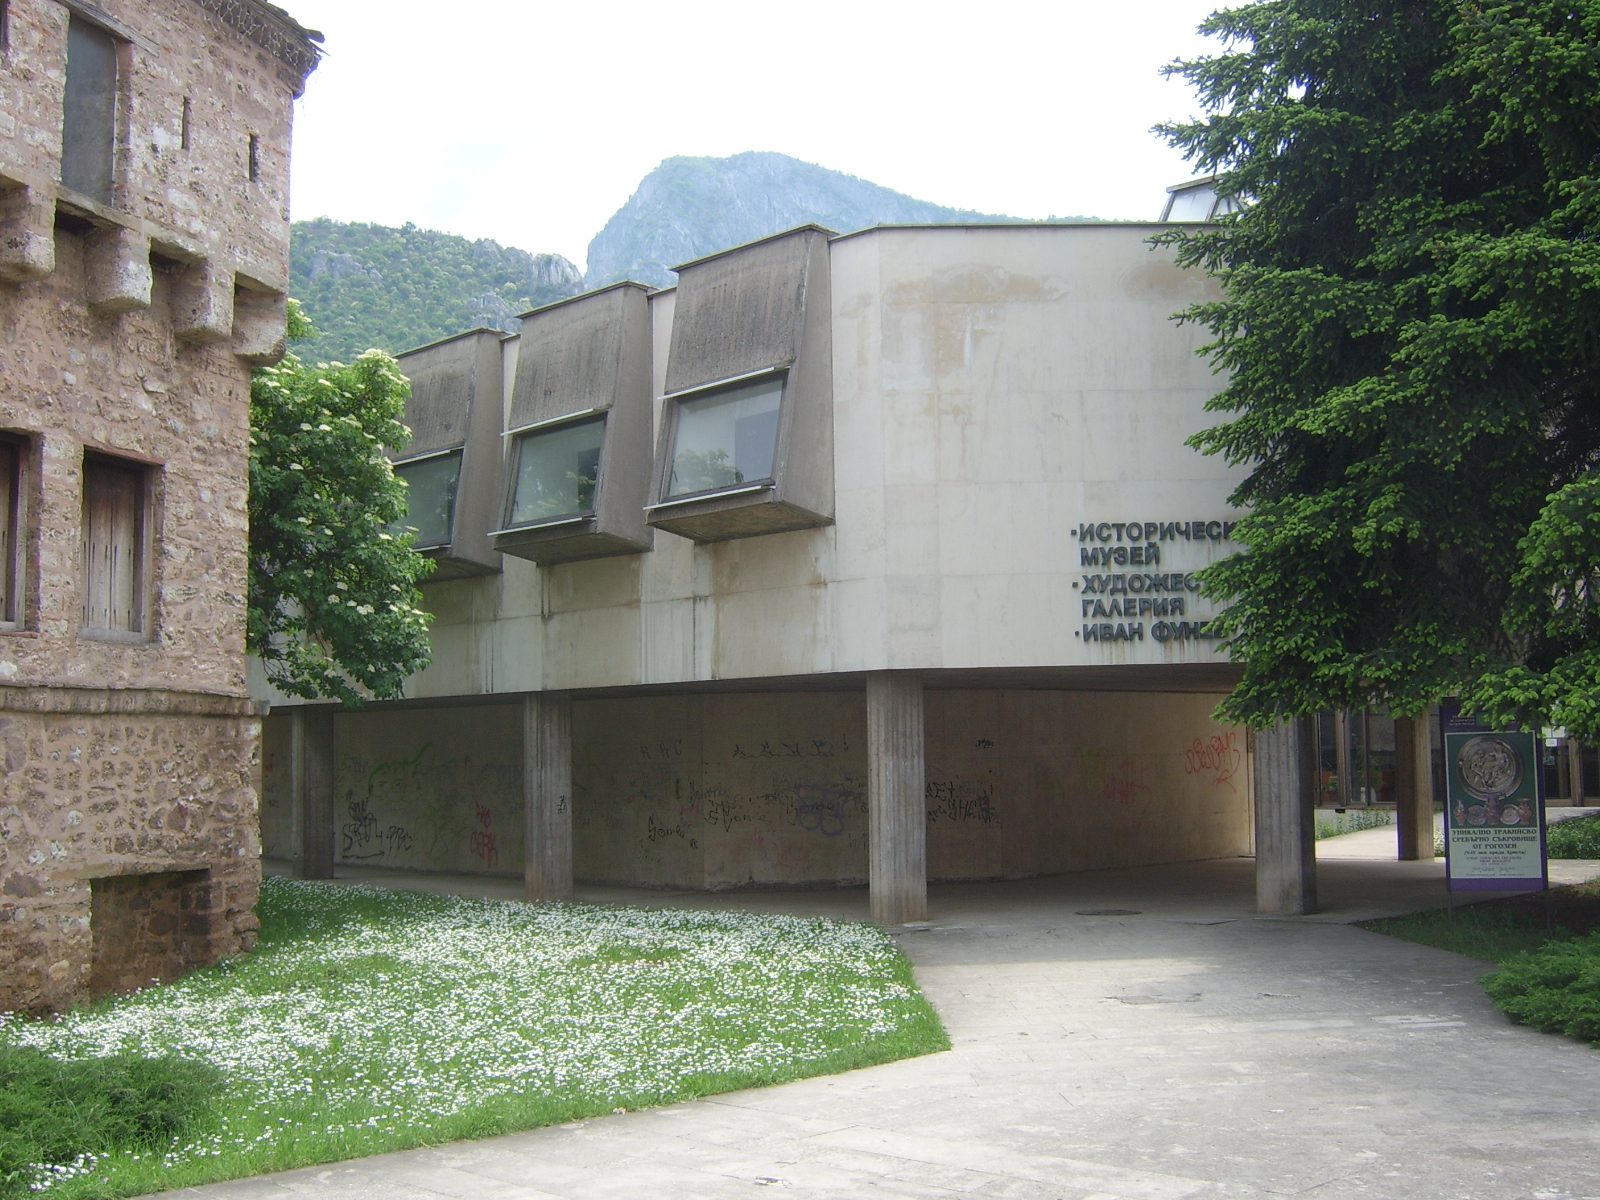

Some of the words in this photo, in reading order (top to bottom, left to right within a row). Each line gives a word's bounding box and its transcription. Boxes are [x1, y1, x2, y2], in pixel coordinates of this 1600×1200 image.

[1080, 542, 1161, 566] МУЗЕЙ
[1081, 572, 1200, 595] ХУДОЖЕС
[1082, 597, 1184, 617] ГАЛЕРИЯ
[1082, 621, 1144, 641] ИВАН
